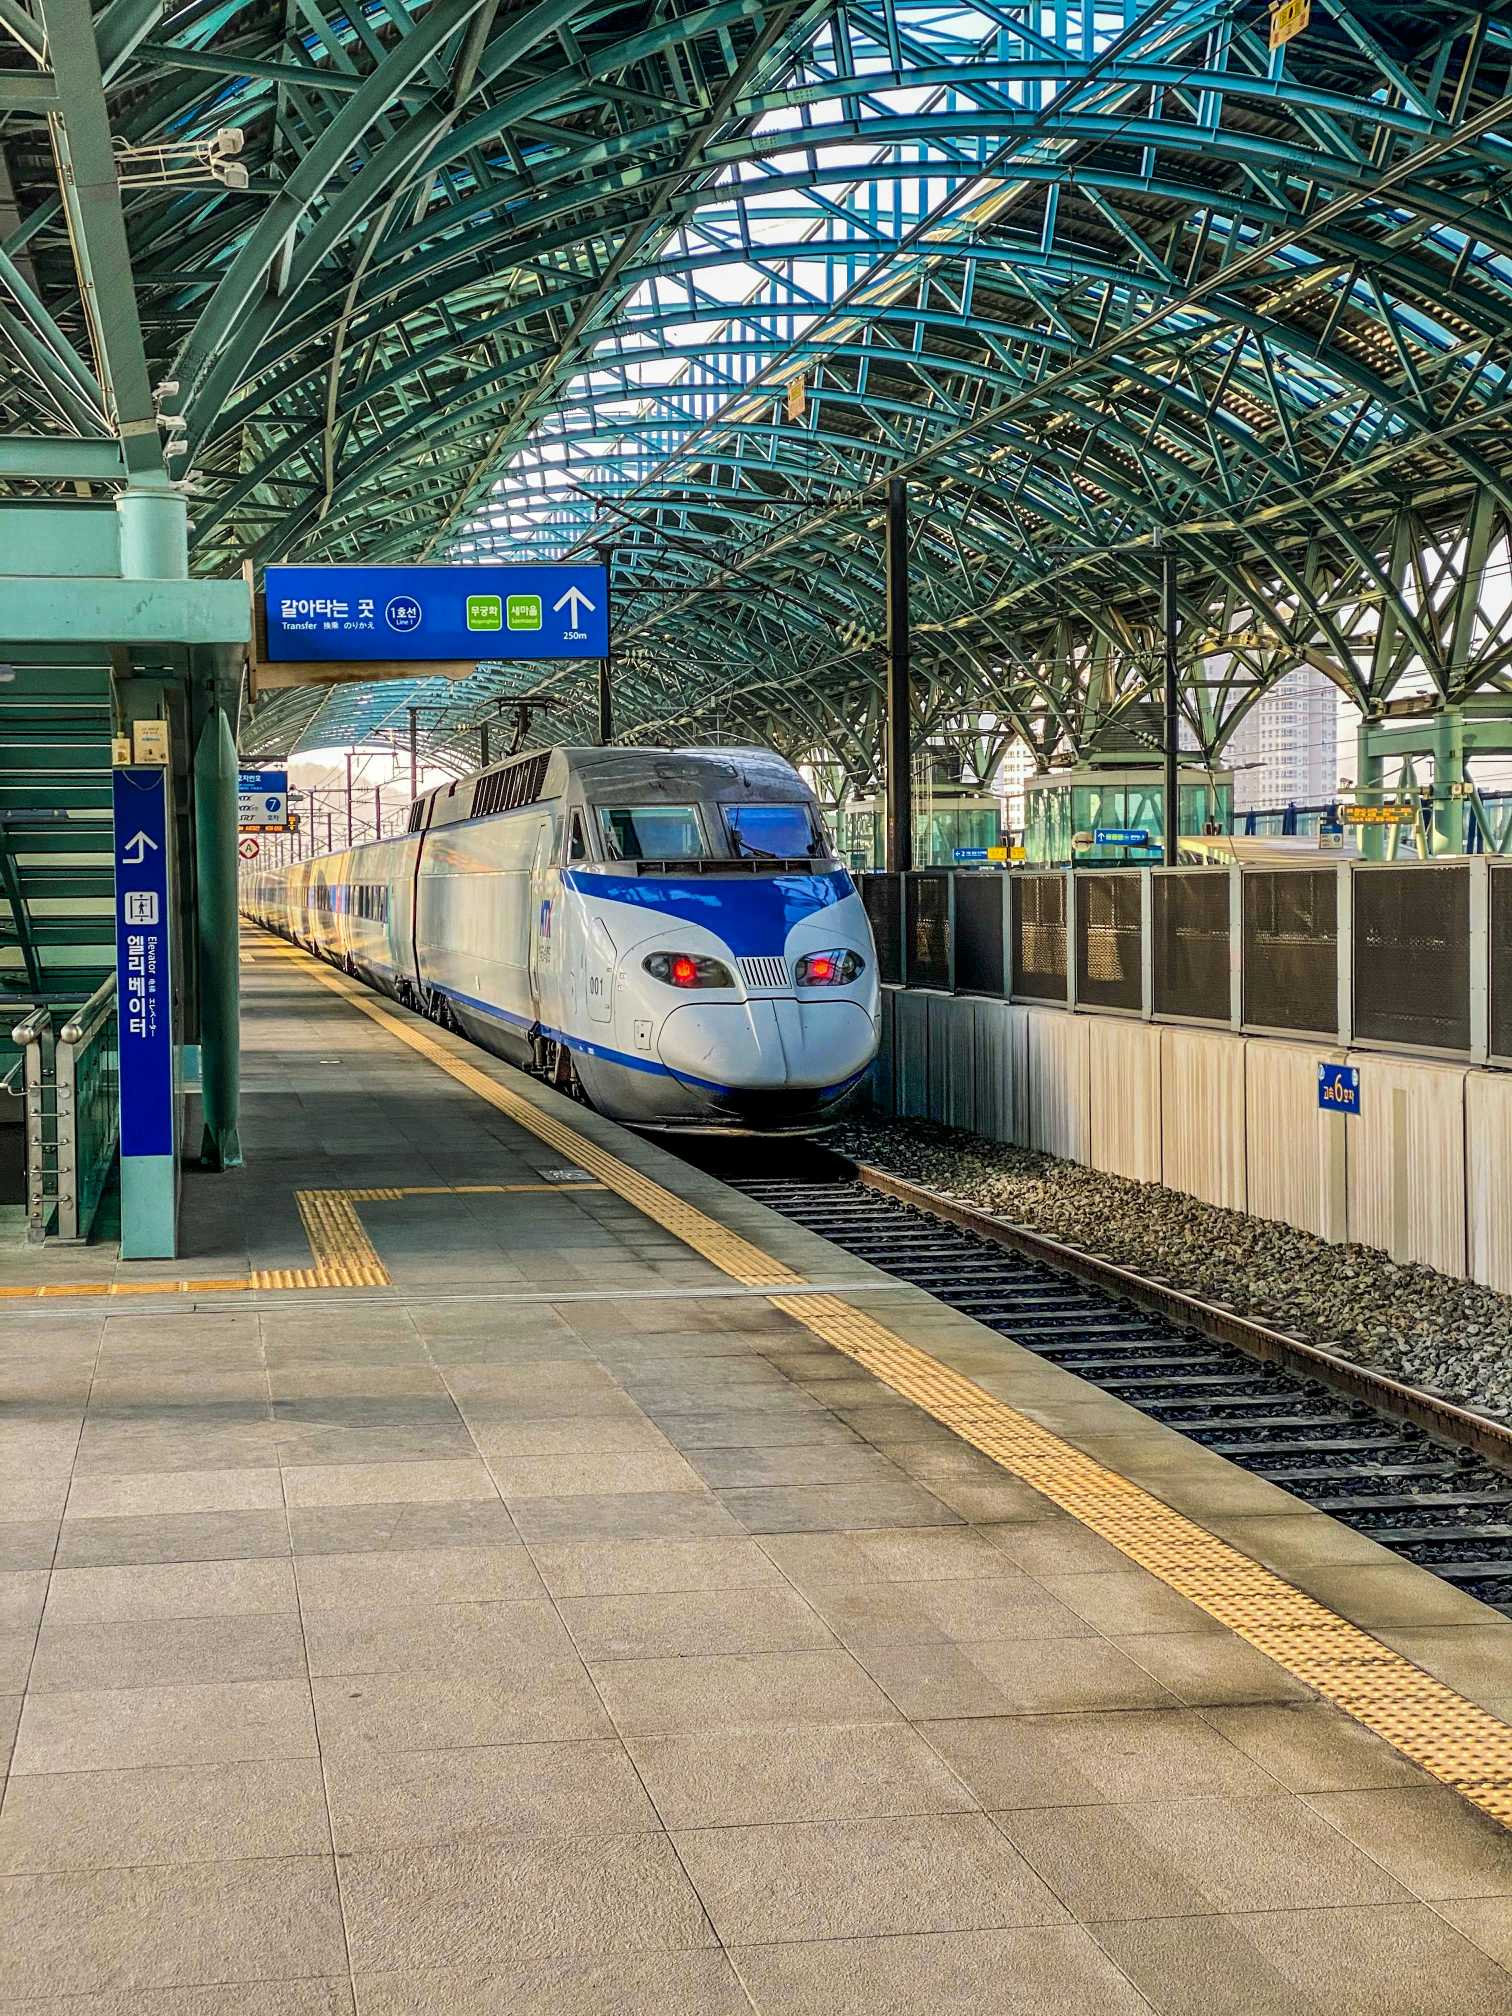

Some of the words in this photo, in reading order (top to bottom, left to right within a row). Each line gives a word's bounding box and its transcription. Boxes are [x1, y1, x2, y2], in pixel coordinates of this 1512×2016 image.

[281, 600, 348, 618] 갈아타는
[358, 600, 374, 618] 곳
[390, 607, 416, 618] 1호선
[471, 605, 498, 617] 무궁화
[511, 605, 538, 617] 새마을
[282, 621, 317, 630] Transfer
[563, 631, 587, 640] 250m
[268, 799, 277, 811] 7
[245, 843, 251, 853] A
[147, 936, 157, 975] Elevator
[127, 935, 146, 1038] 엘리베이터
[590, 976, 603, 996] 001
